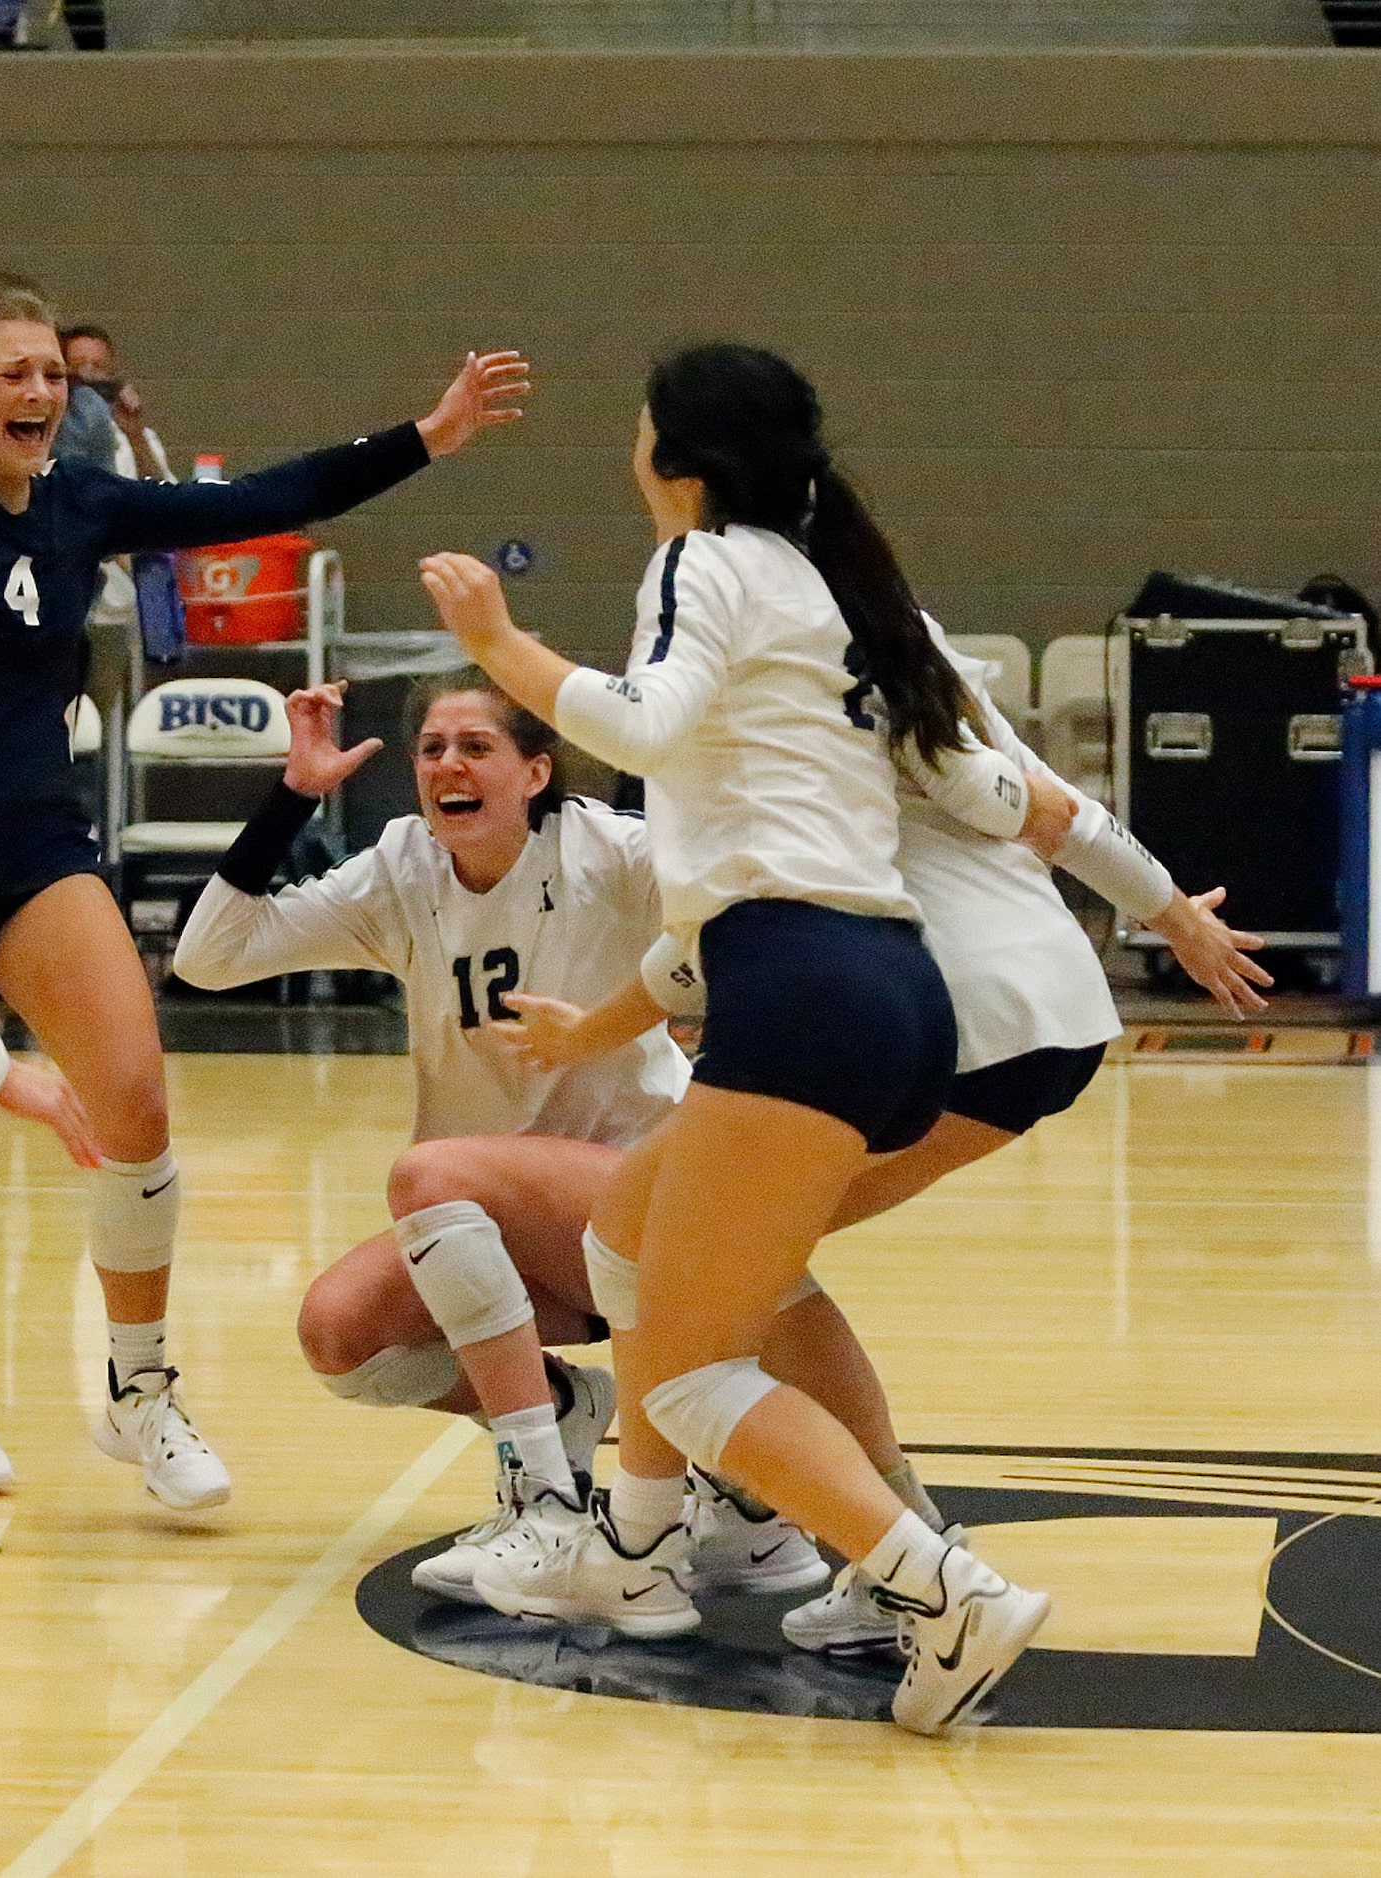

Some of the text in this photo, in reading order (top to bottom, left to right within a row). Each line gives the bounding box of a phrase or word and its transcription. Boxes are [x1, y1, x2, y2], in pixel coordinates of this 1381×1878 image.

[3, 554, 40, 626] 4
[159, 693, 271, 732] BISD
[452, 946, 521, 1028] 12
